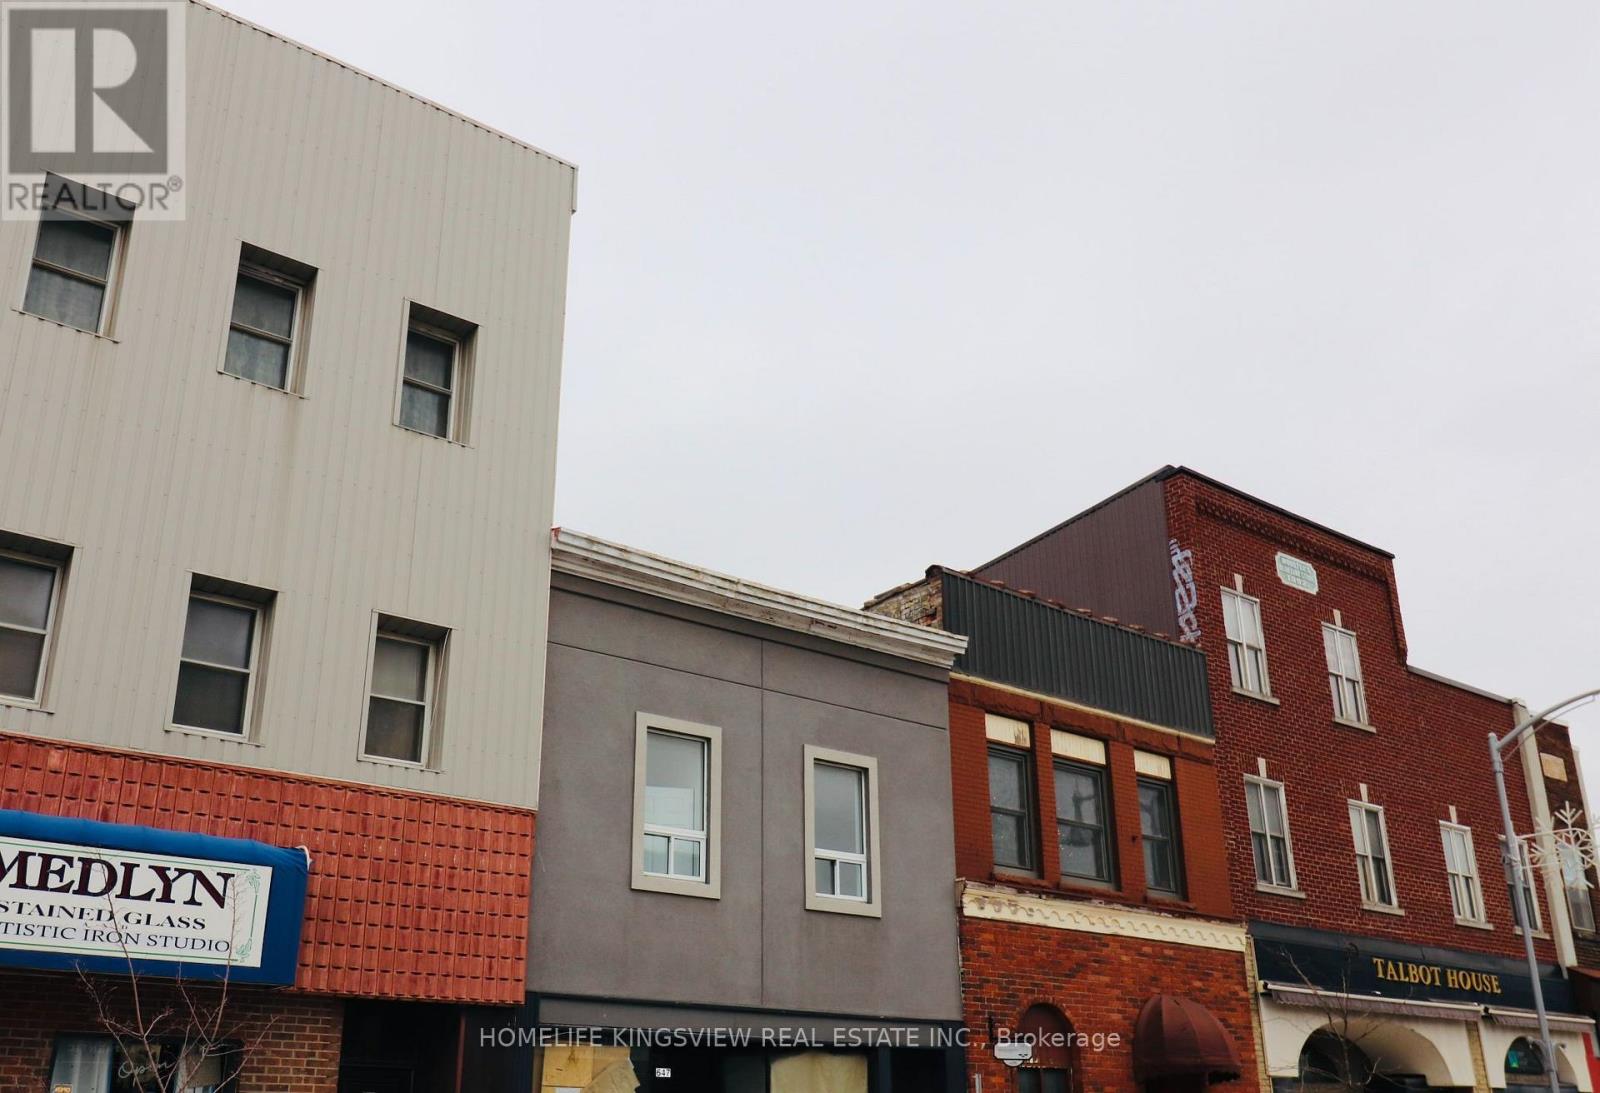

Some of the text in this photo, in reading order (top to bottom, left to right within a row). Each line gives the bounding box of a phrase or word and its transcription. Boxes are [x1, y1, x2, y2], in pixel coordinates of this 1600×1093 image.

[0, 900, 207, 931] STAINED GLASS
[84, 929, 140, 946] IRON
[146, 934, 230, 952] STUDIO
[1373, 958, 1502, 994] TALBOT HOUSE
